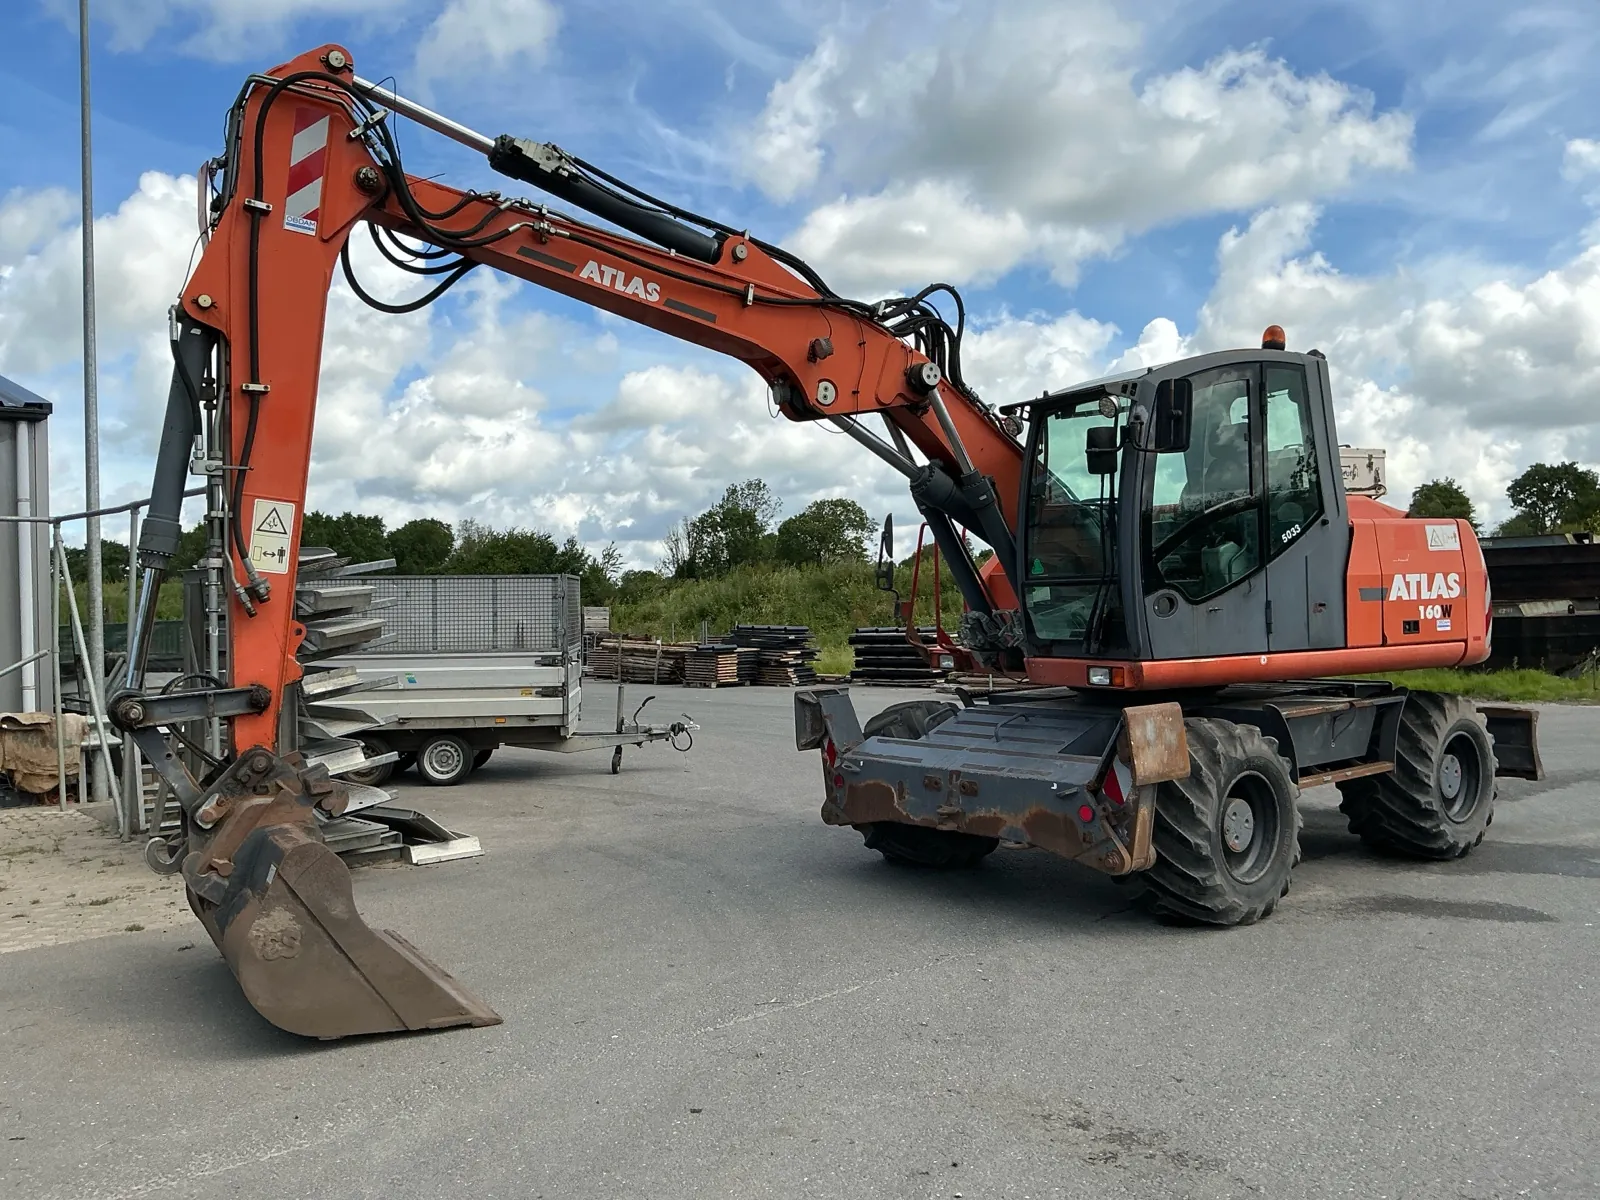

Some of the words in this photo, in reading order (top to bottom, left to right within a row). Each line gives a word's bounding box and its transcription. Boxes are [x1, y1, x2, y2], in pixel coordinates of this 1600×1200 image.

[286, 215, 316, 227] OBDAM
[579, 260, 660, 302] ATLAS
[1281, 524, 1301, 543] 5033
[1388, 573, 1460, 601] ATLAS
[1419, 604, 1452, 619] 160W
